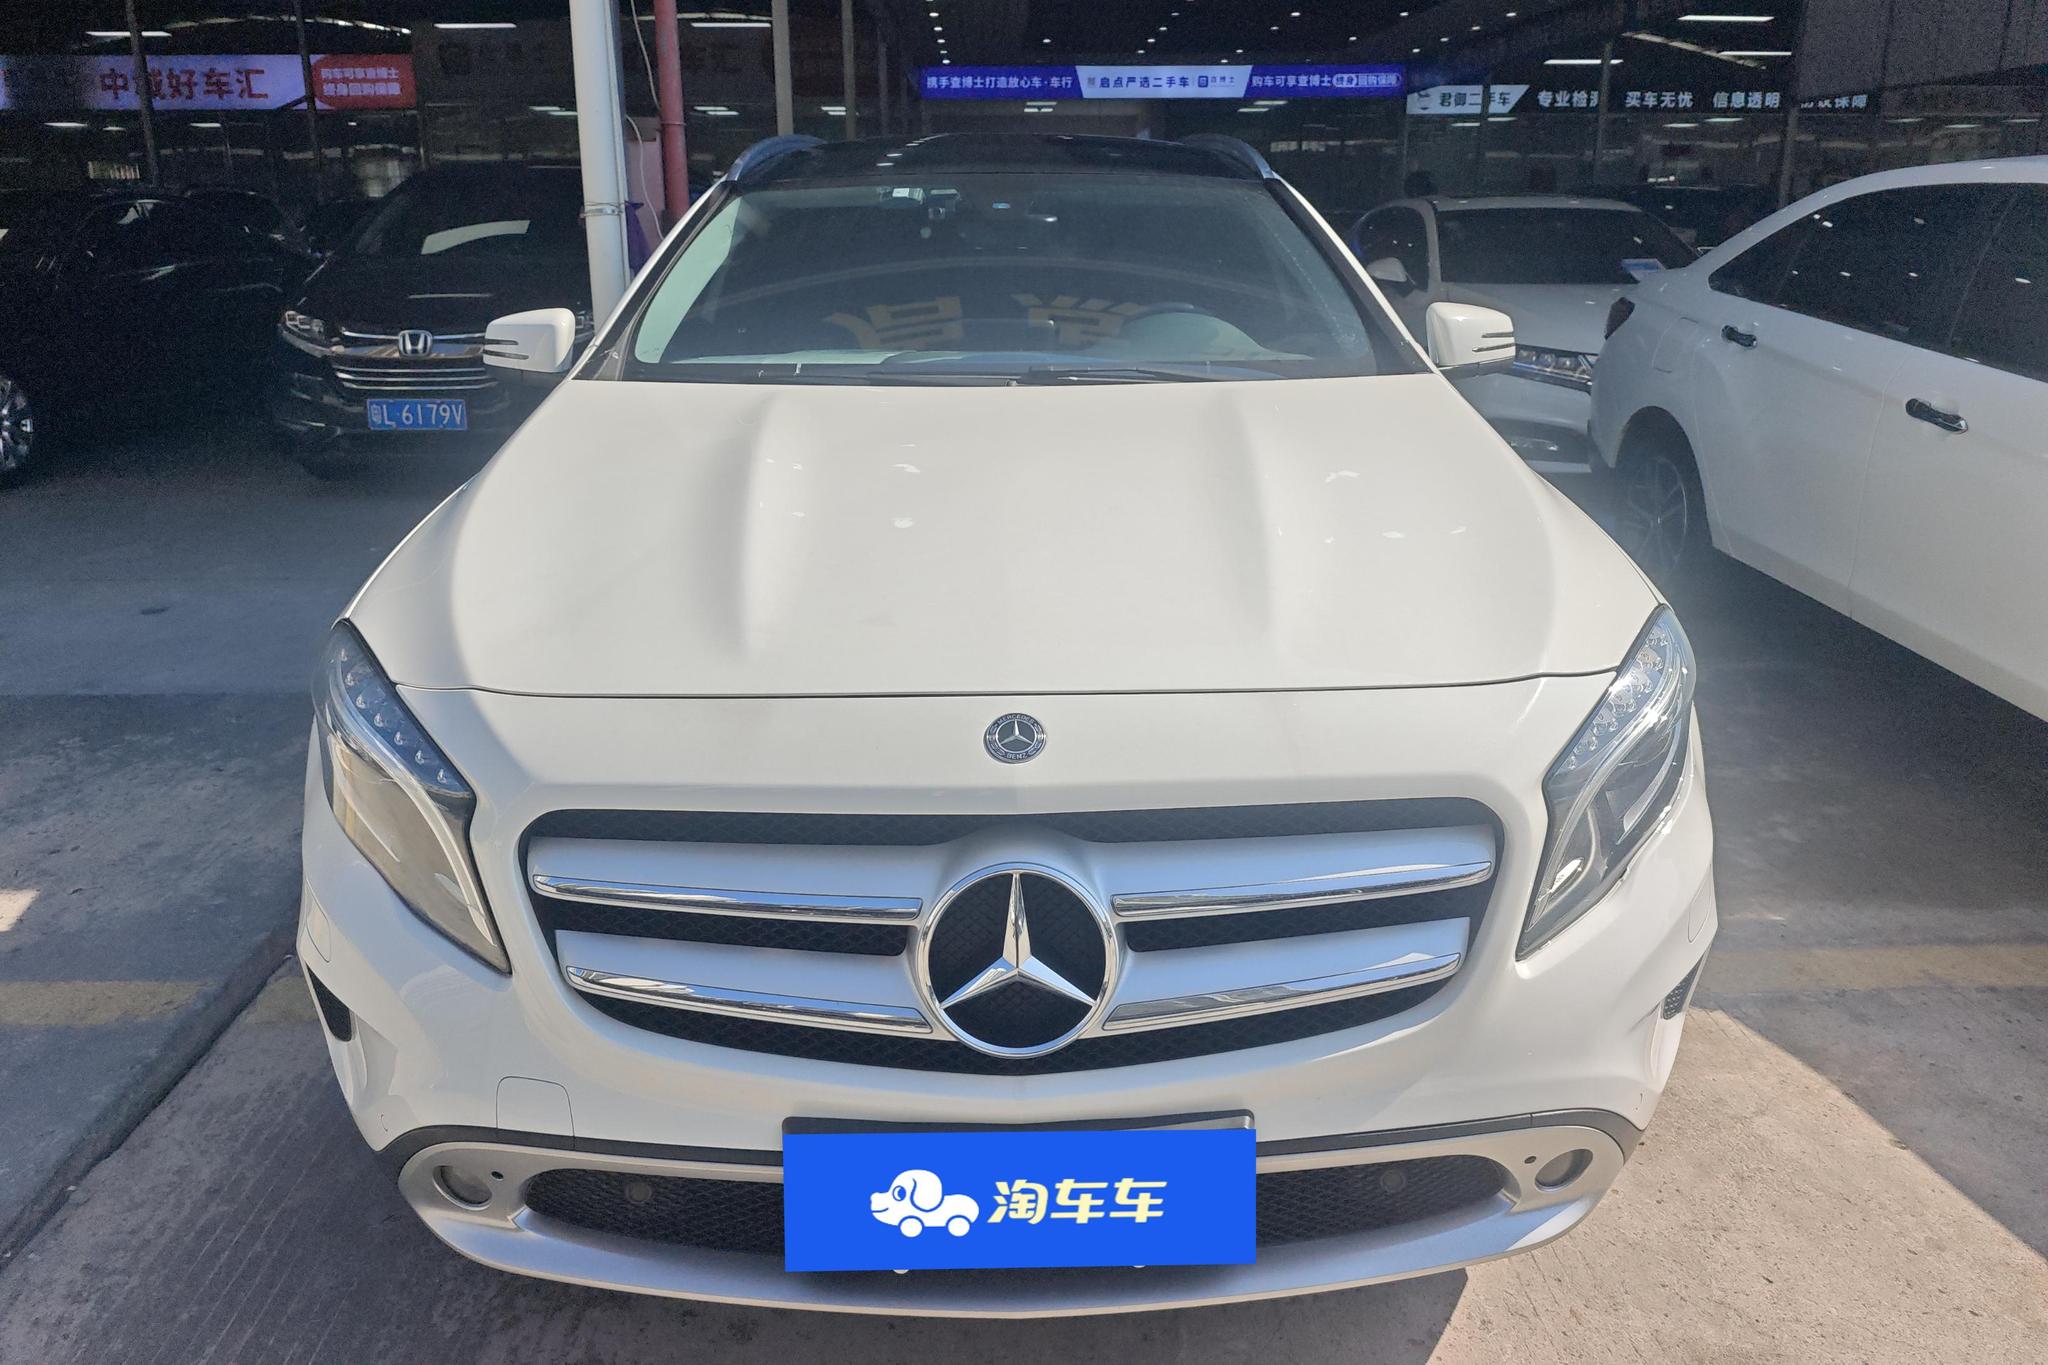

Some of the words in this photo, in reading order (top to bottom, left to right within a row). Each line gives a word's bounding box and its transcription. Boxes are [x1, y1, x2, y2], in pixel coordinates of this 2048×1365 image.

[1625, 90, 1694, 108] 买车无忧
[1712, 90, 1781, 109] 信息透明
